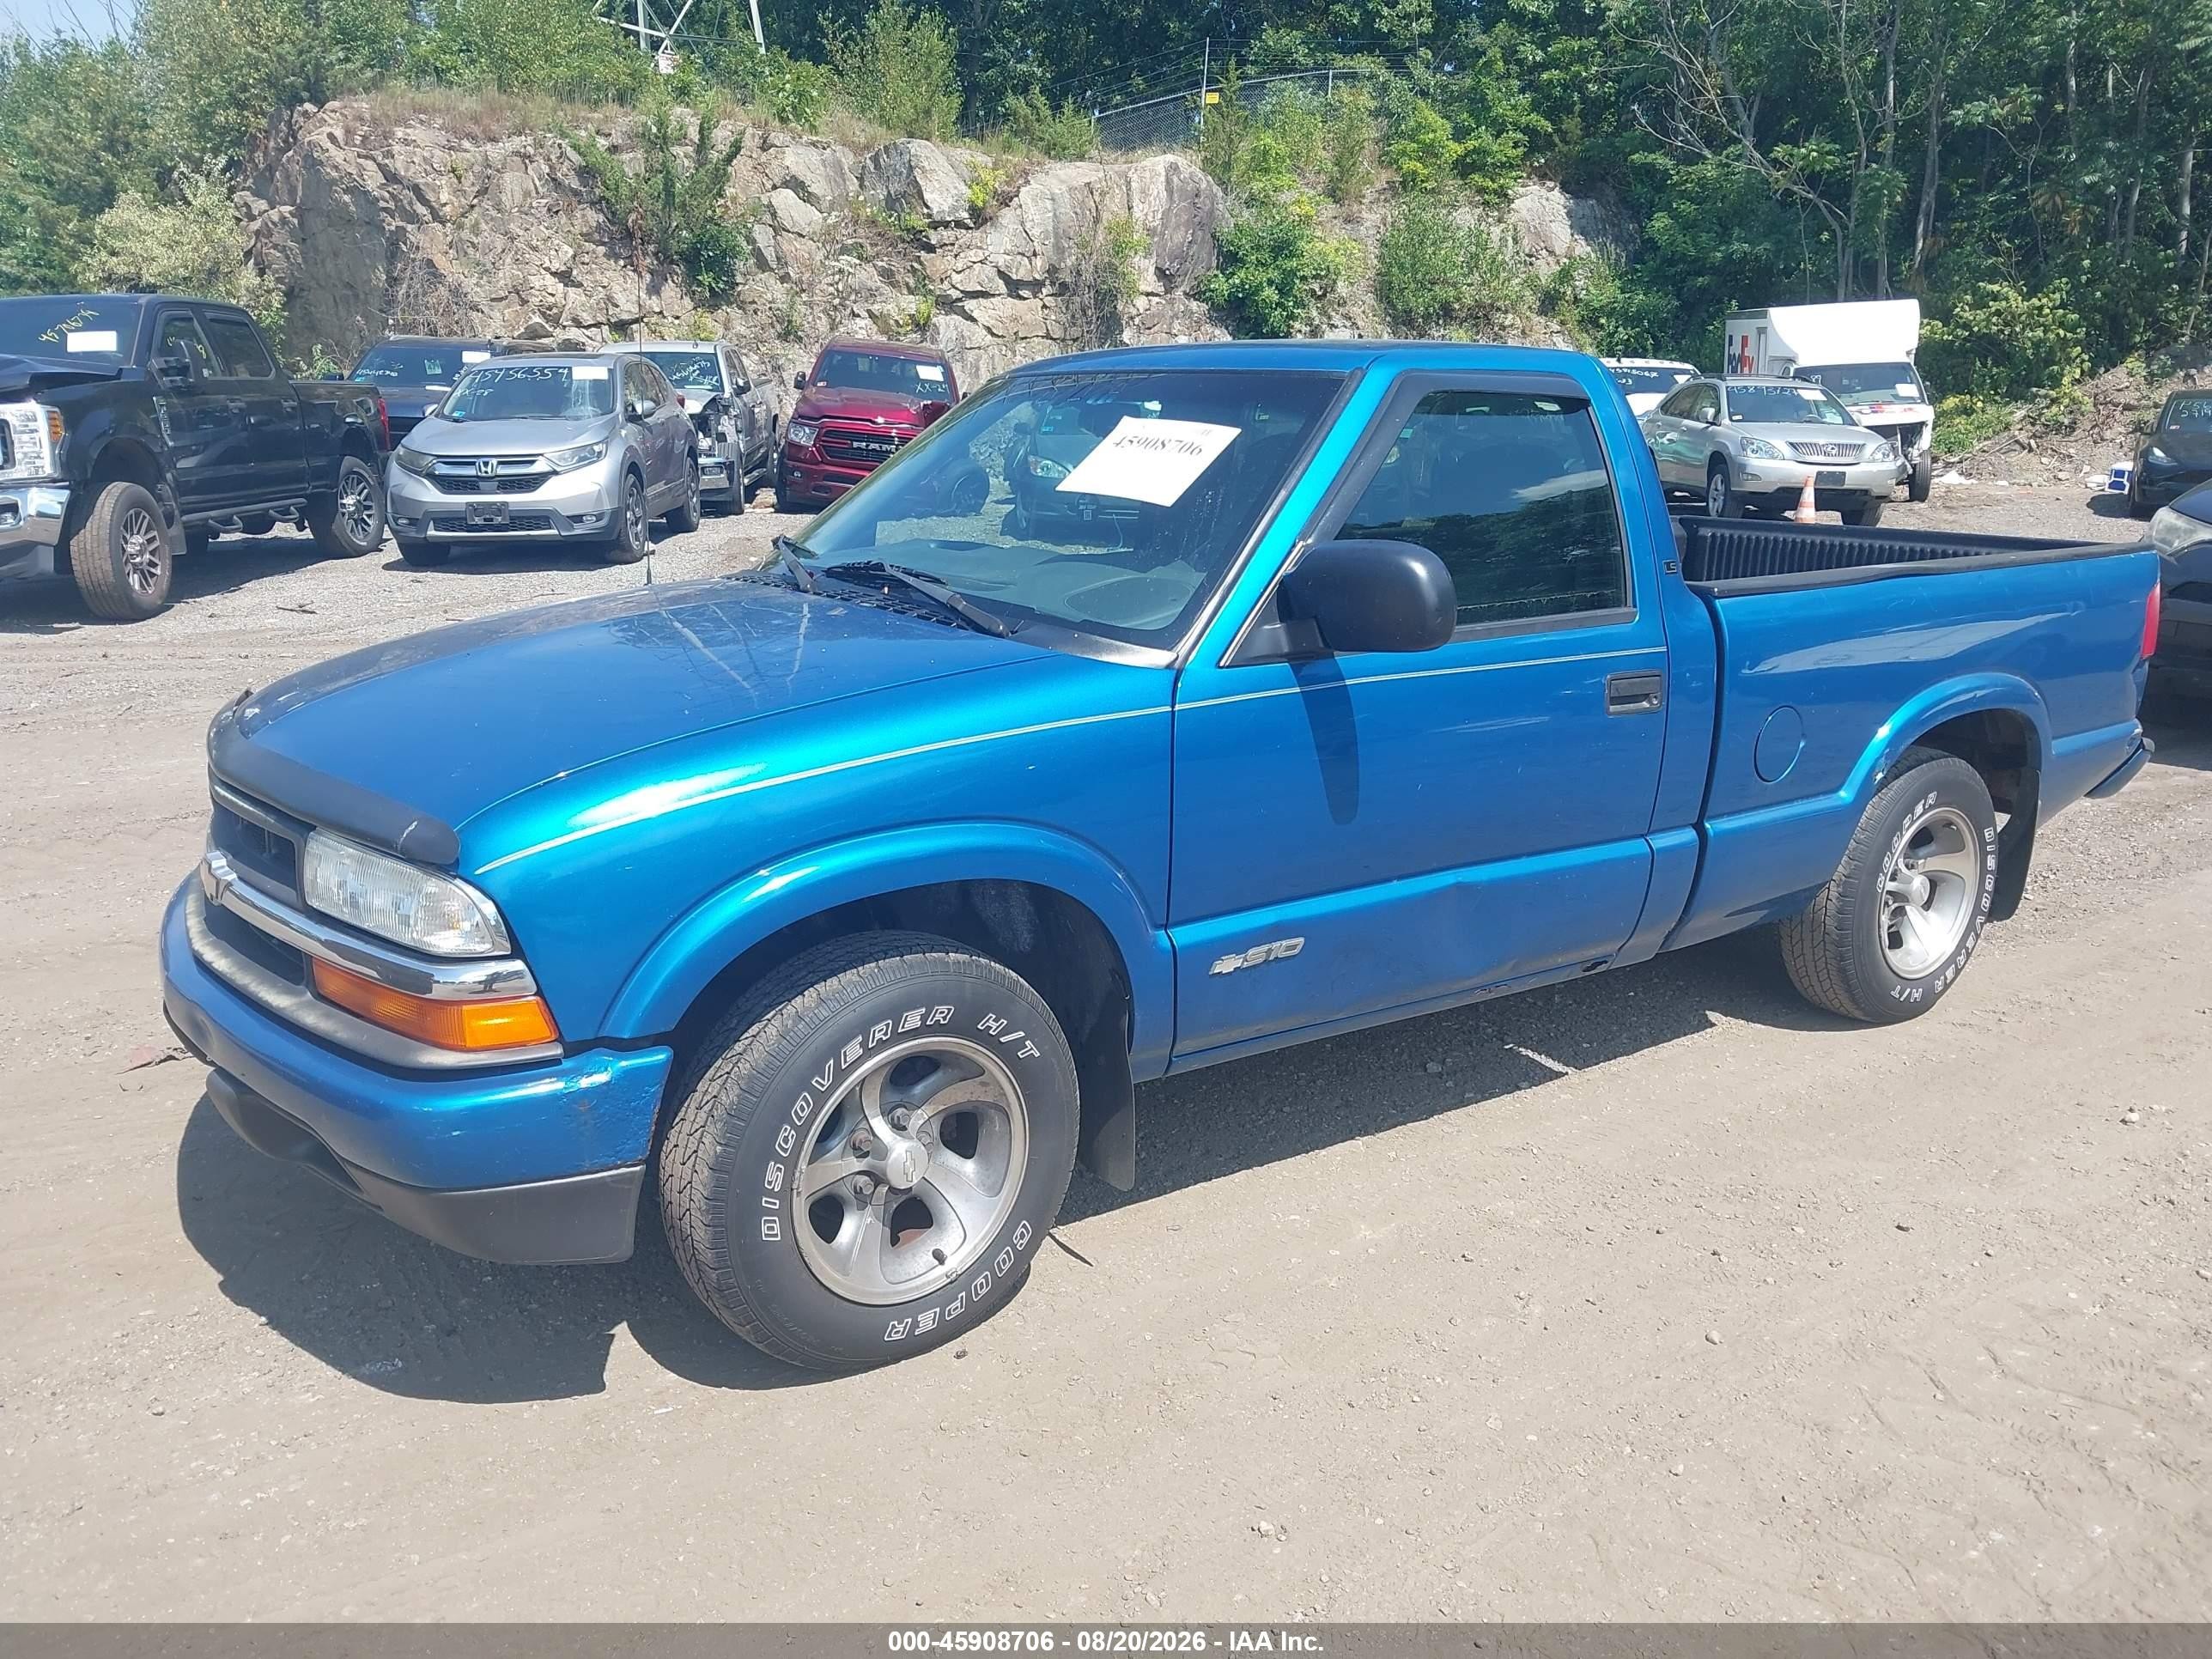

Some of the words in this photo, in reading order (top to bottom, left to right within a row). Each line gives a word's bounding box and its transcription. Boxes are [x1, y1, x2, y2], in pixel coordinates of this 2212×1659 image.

[1112, 434, 1203, 457] 45908706
[1875, 790, 1938, 894] COOPER
[1240, 936, 1306, 969] S10
[1934, 826, 1997, 994] DISCOVERER
[1890, 985, 1923, 1003] H/T
[761, 1006, 955, 1242] DISCOVERER
[976, 1012, 1042, 1061] H/T
[883, 1219, 1033, 1342] COOPER
